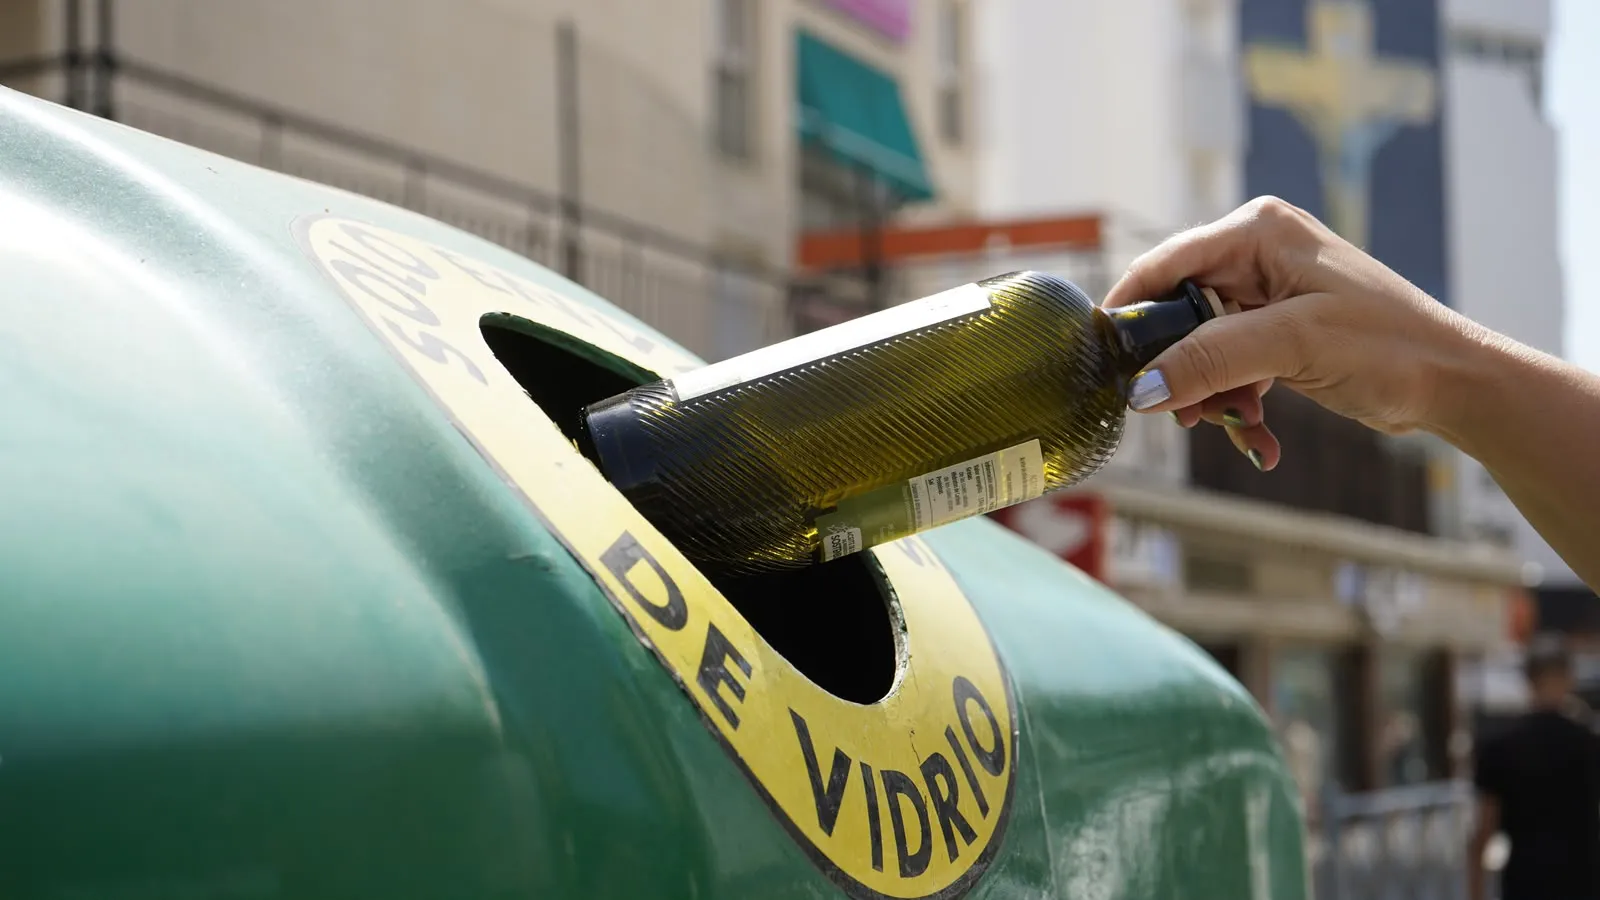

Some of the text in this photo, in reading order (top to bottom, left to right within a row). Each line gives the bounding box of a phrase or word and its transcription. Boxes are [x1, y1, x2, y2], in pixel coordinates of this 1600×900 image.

[329, 223, 488, 386] SOLO
[598, 530, 1006, 878] DE VIDRIO
